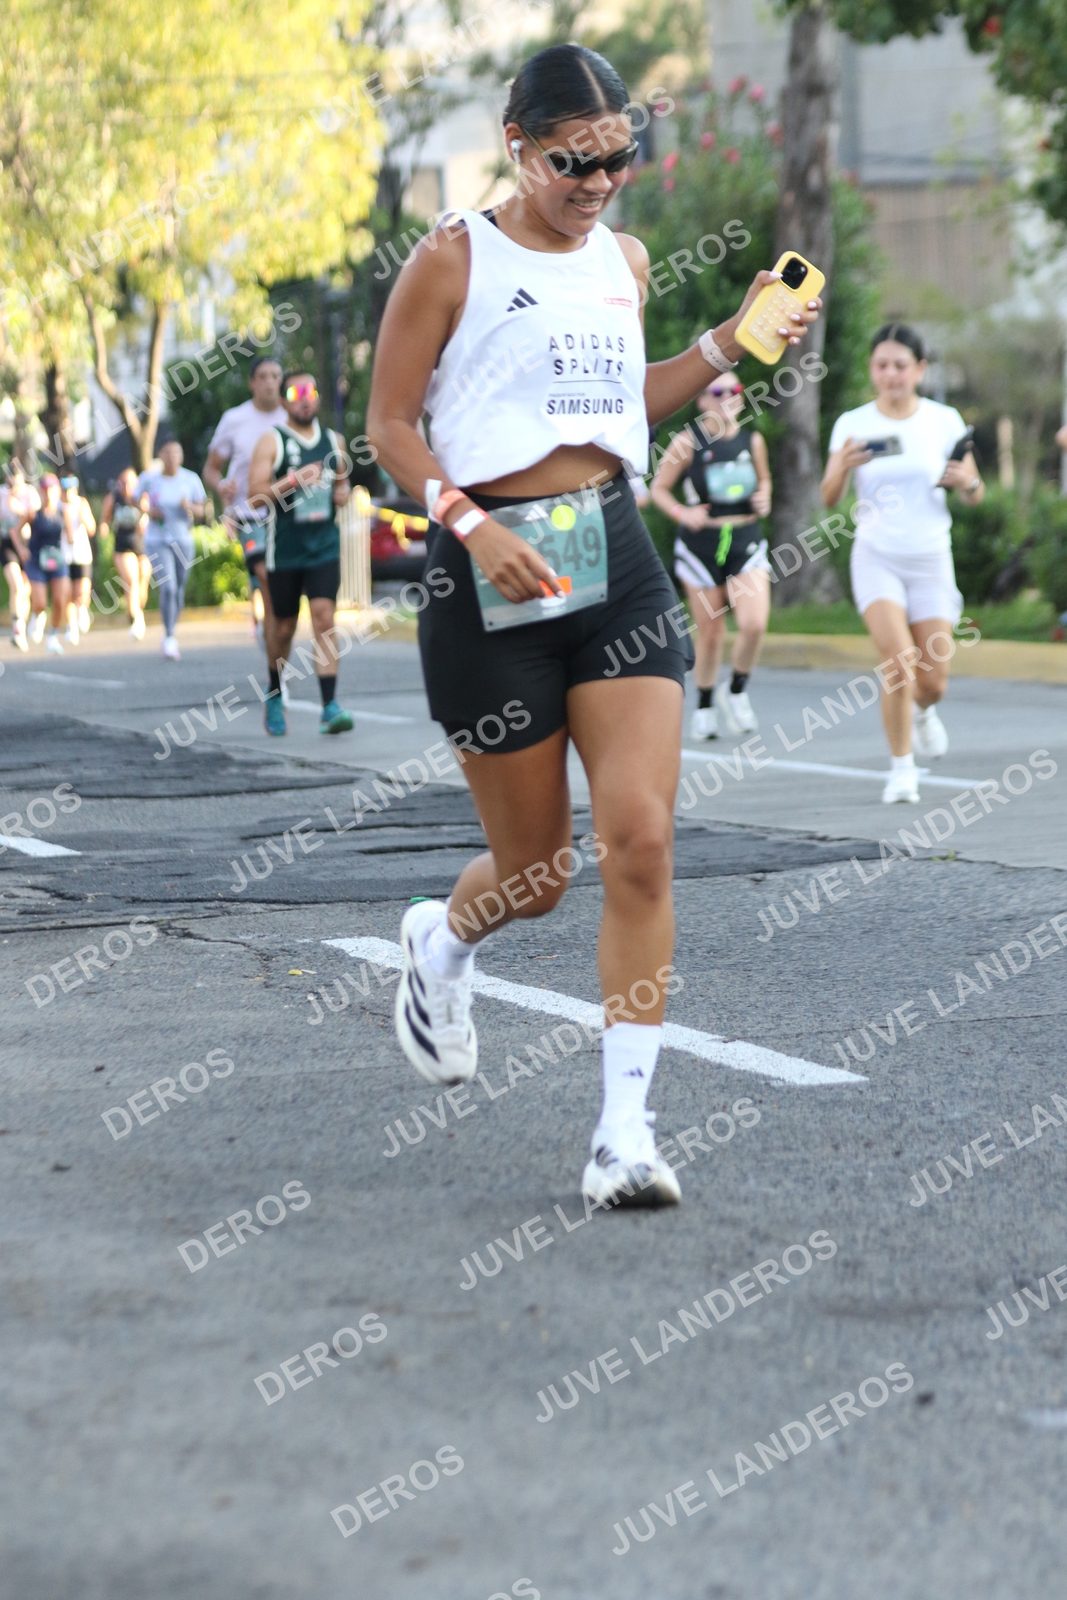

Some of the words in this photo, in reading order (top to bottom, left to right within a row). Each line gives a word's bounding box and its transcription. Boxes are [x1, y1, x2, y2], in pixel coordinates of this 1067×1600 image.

[549, 334, 625, 353] ADIDAS
[553, 358, 624, 376] SPLITS
[546, 399, 624, 415] SAMSUNG
